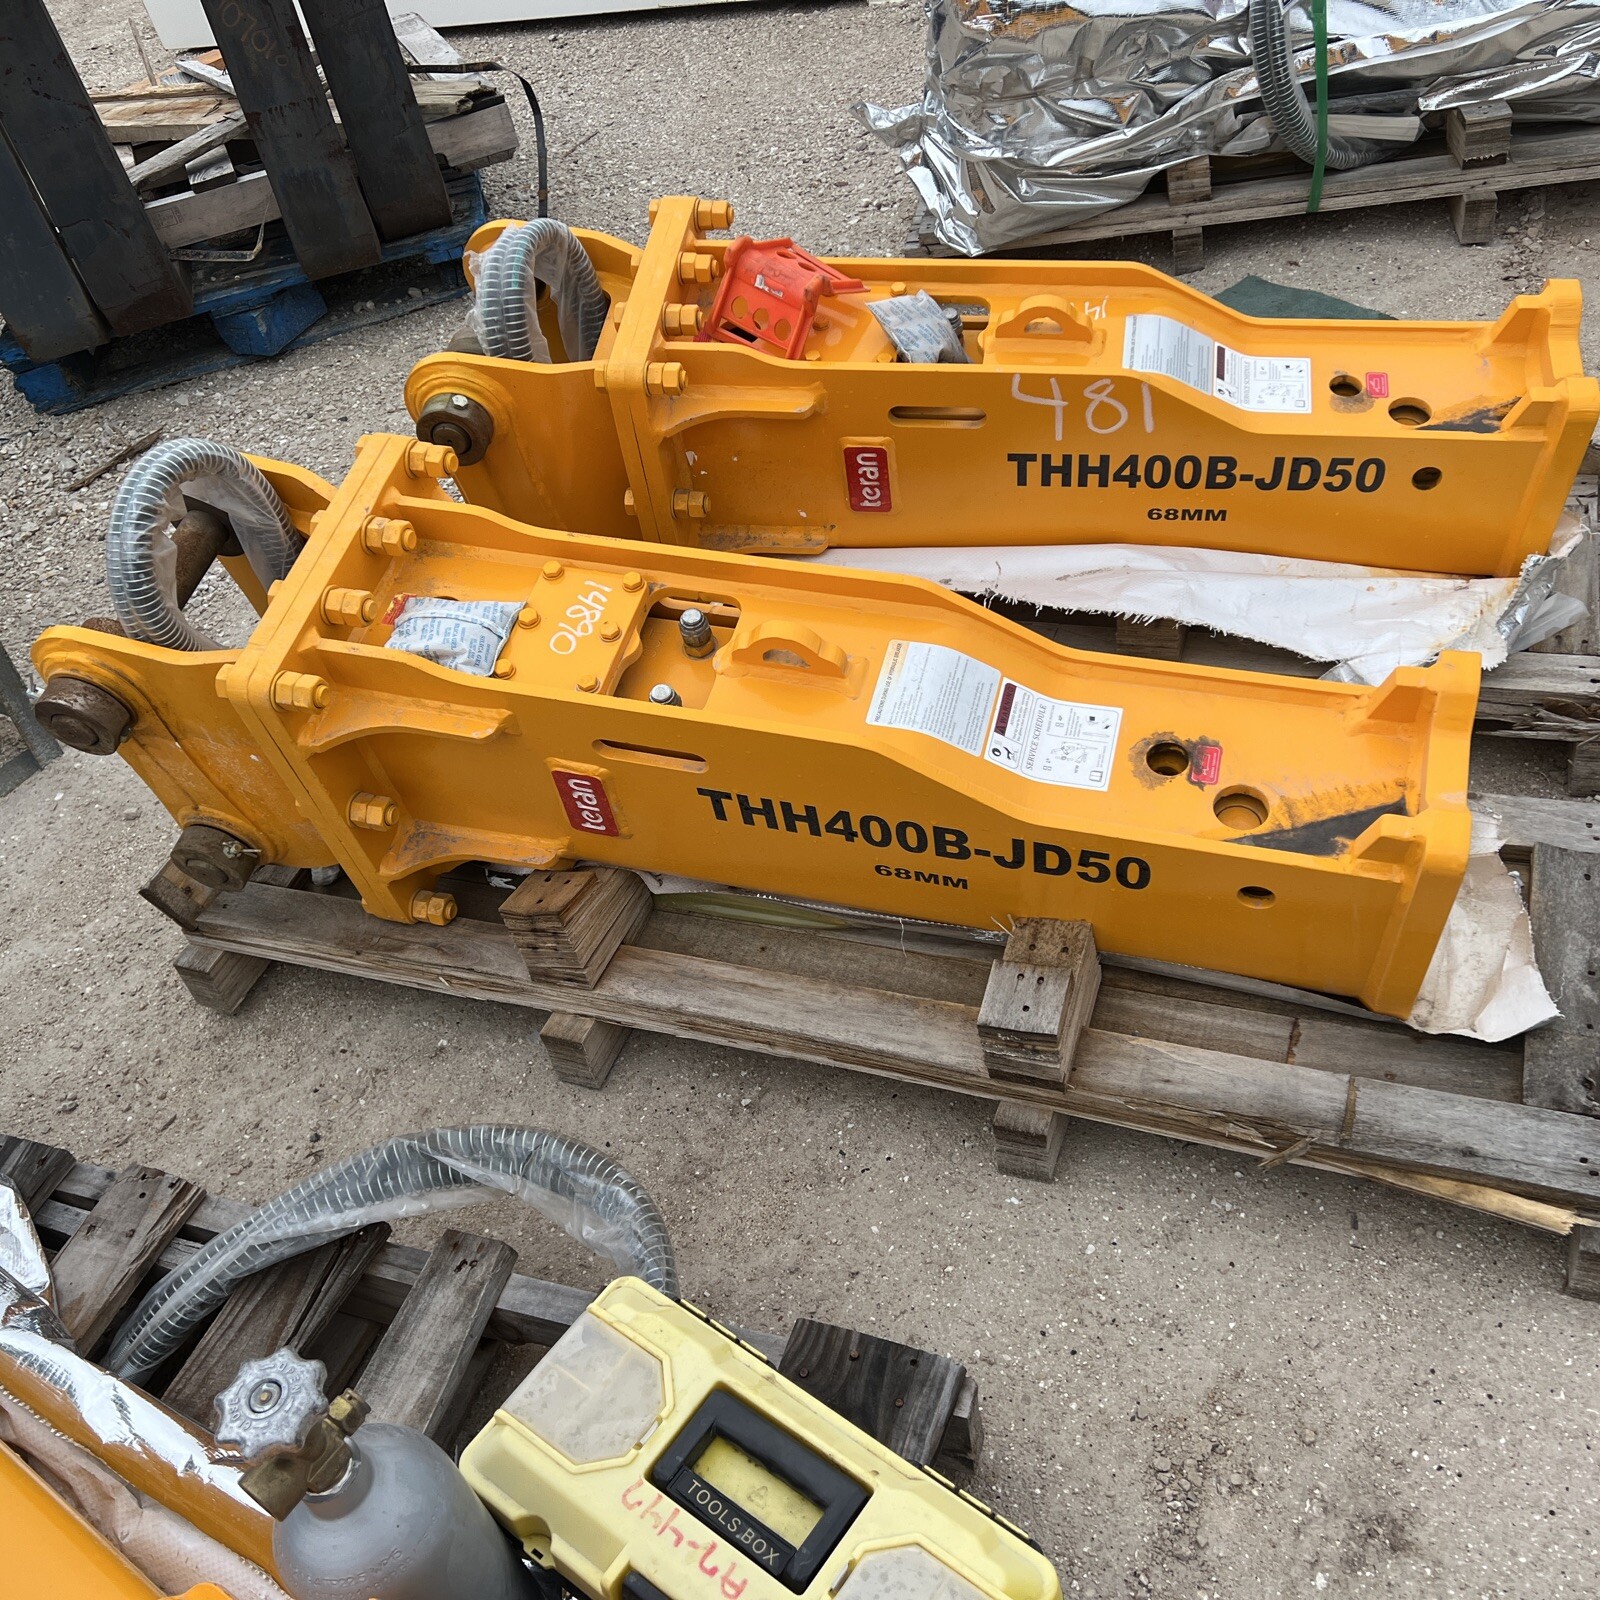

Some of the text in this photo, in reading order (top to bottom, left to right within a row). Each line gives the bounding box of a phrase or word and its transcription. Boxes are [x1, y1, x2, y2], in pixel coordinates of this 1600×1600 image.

[1012, 373, 1154, 441] 481
[856, 453, 881, 507] teran
[1007, 453, 1387, 494] THH400B-JD50
[1146, 508, 1228, 522] 68MM
[549, 580, 613, 655] 14890
[1000, 685, 1015, 727] WARNING
[1026, 704, 1047, 771] SERVICE SCHEDULE
[568, 779, 606, 830] teran
[696, 787, 1151, 890] THH400B-JD50
[874, 864, 969, 890] 68MM
